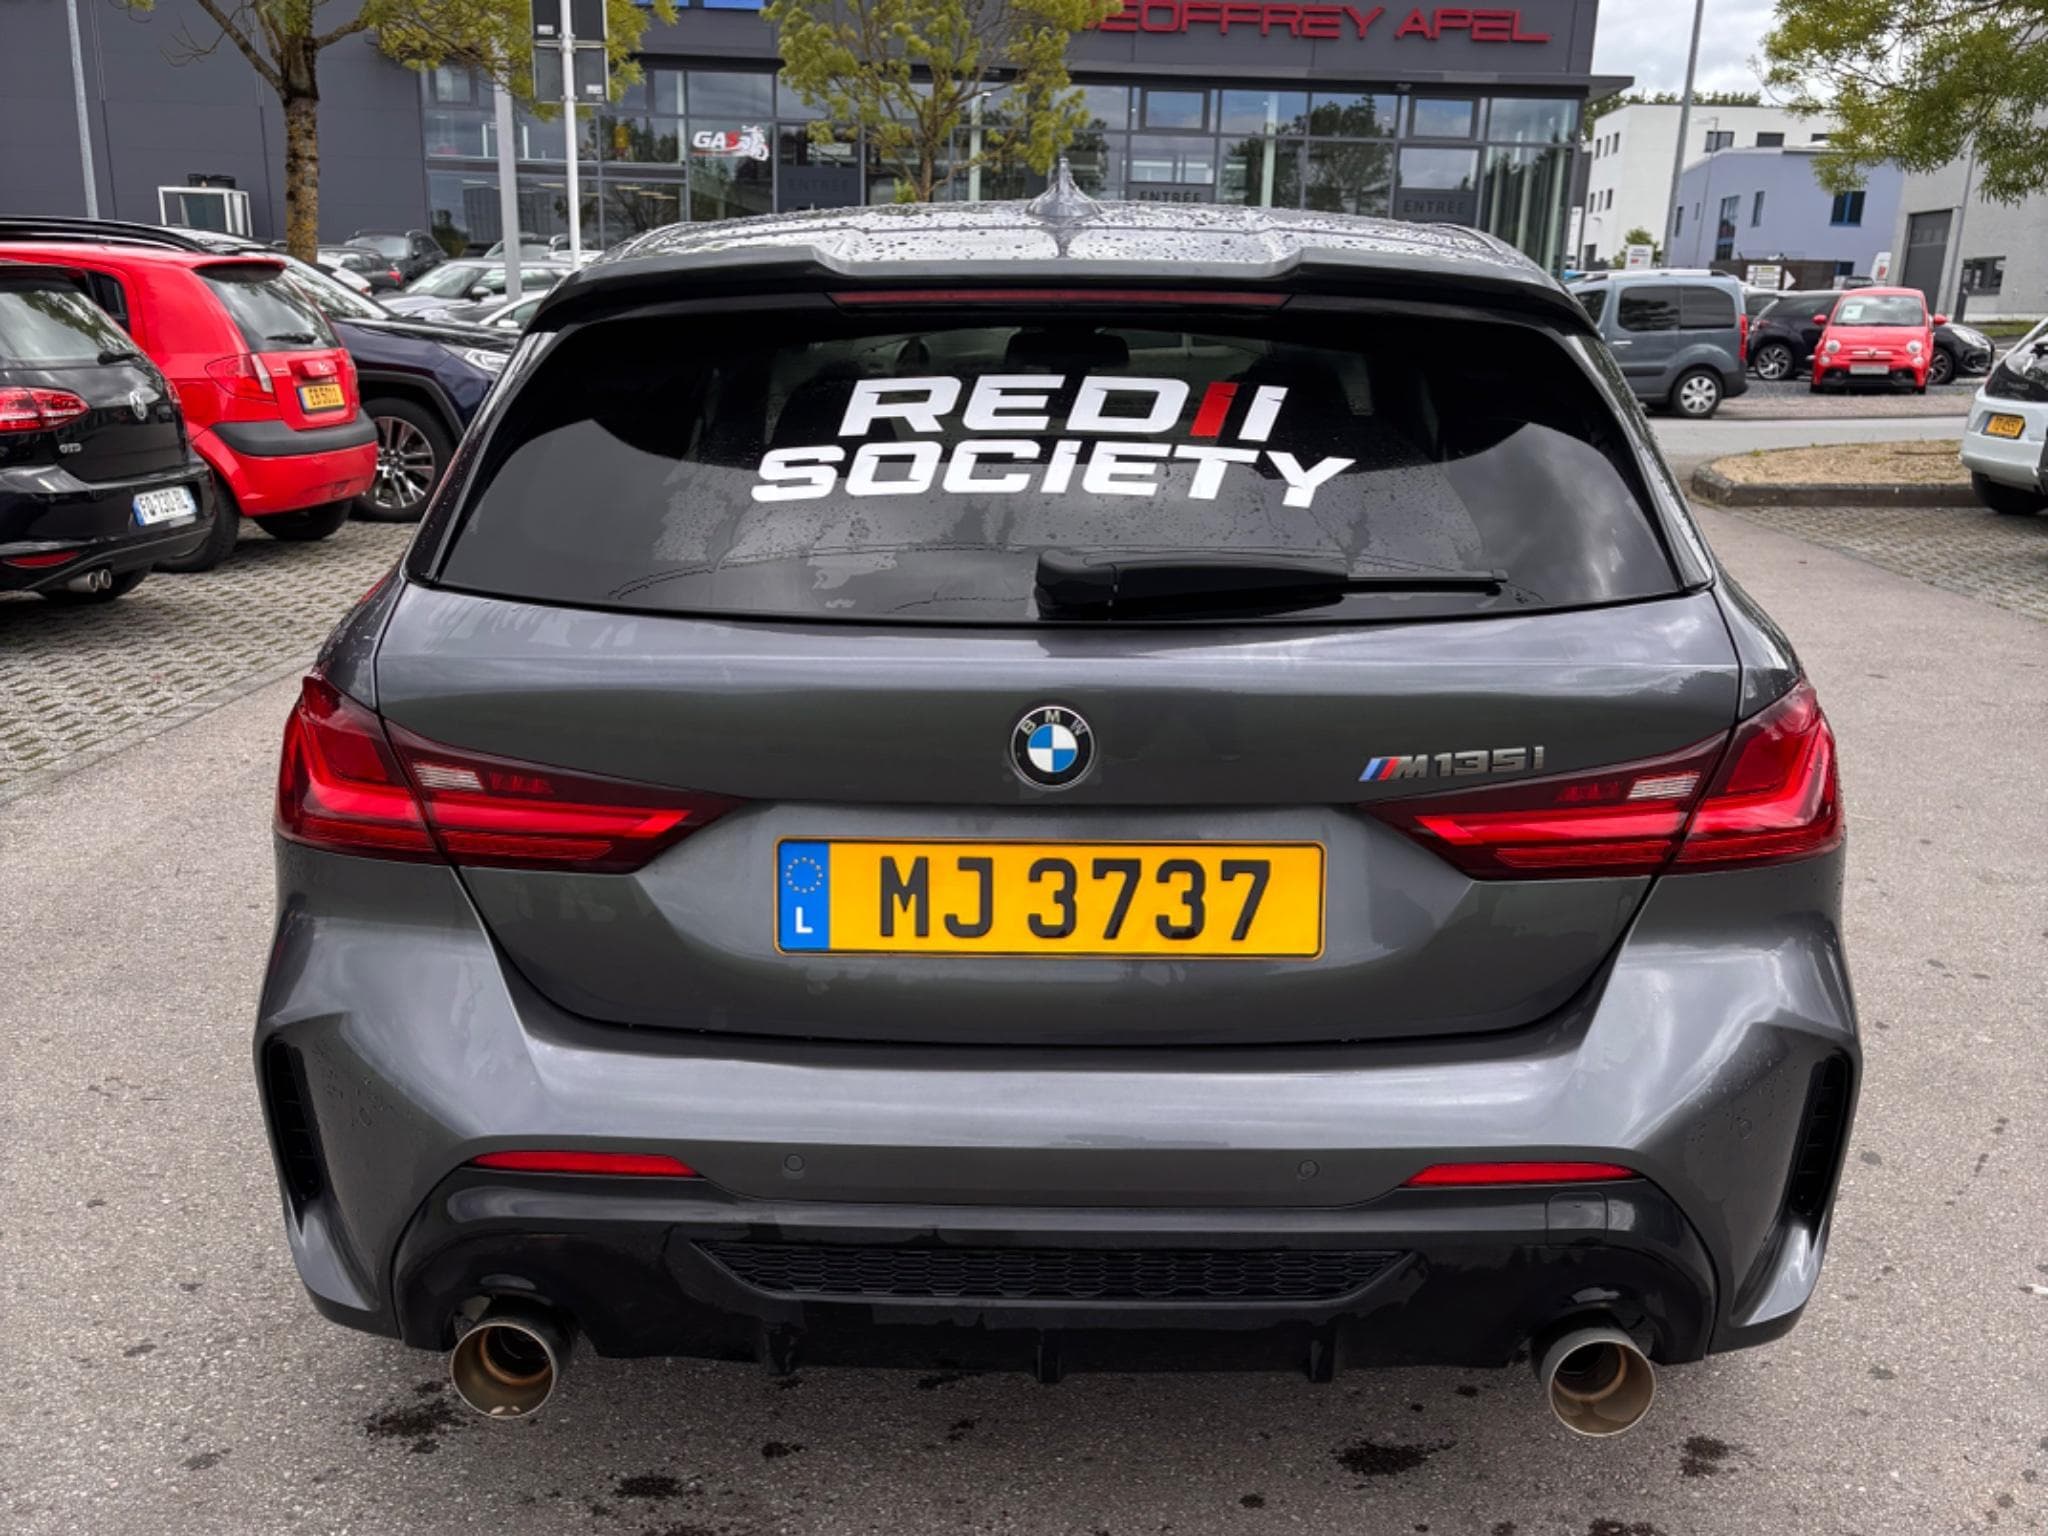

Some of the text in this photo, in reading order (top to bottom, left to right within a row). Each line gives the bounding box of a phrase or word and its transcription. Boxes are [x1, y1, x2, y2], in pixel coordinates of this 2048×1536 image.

[1085, 0, 1551, 43] EOFFREY APEL
[692, 131, 741, 149] GAS
[751, 440, 1356, 508] SOCIETY
[1020, 709, 1087, 736] BMW
[880, 856, 1271, 941] MJ 3737
[794, 906, 813, 934] L
